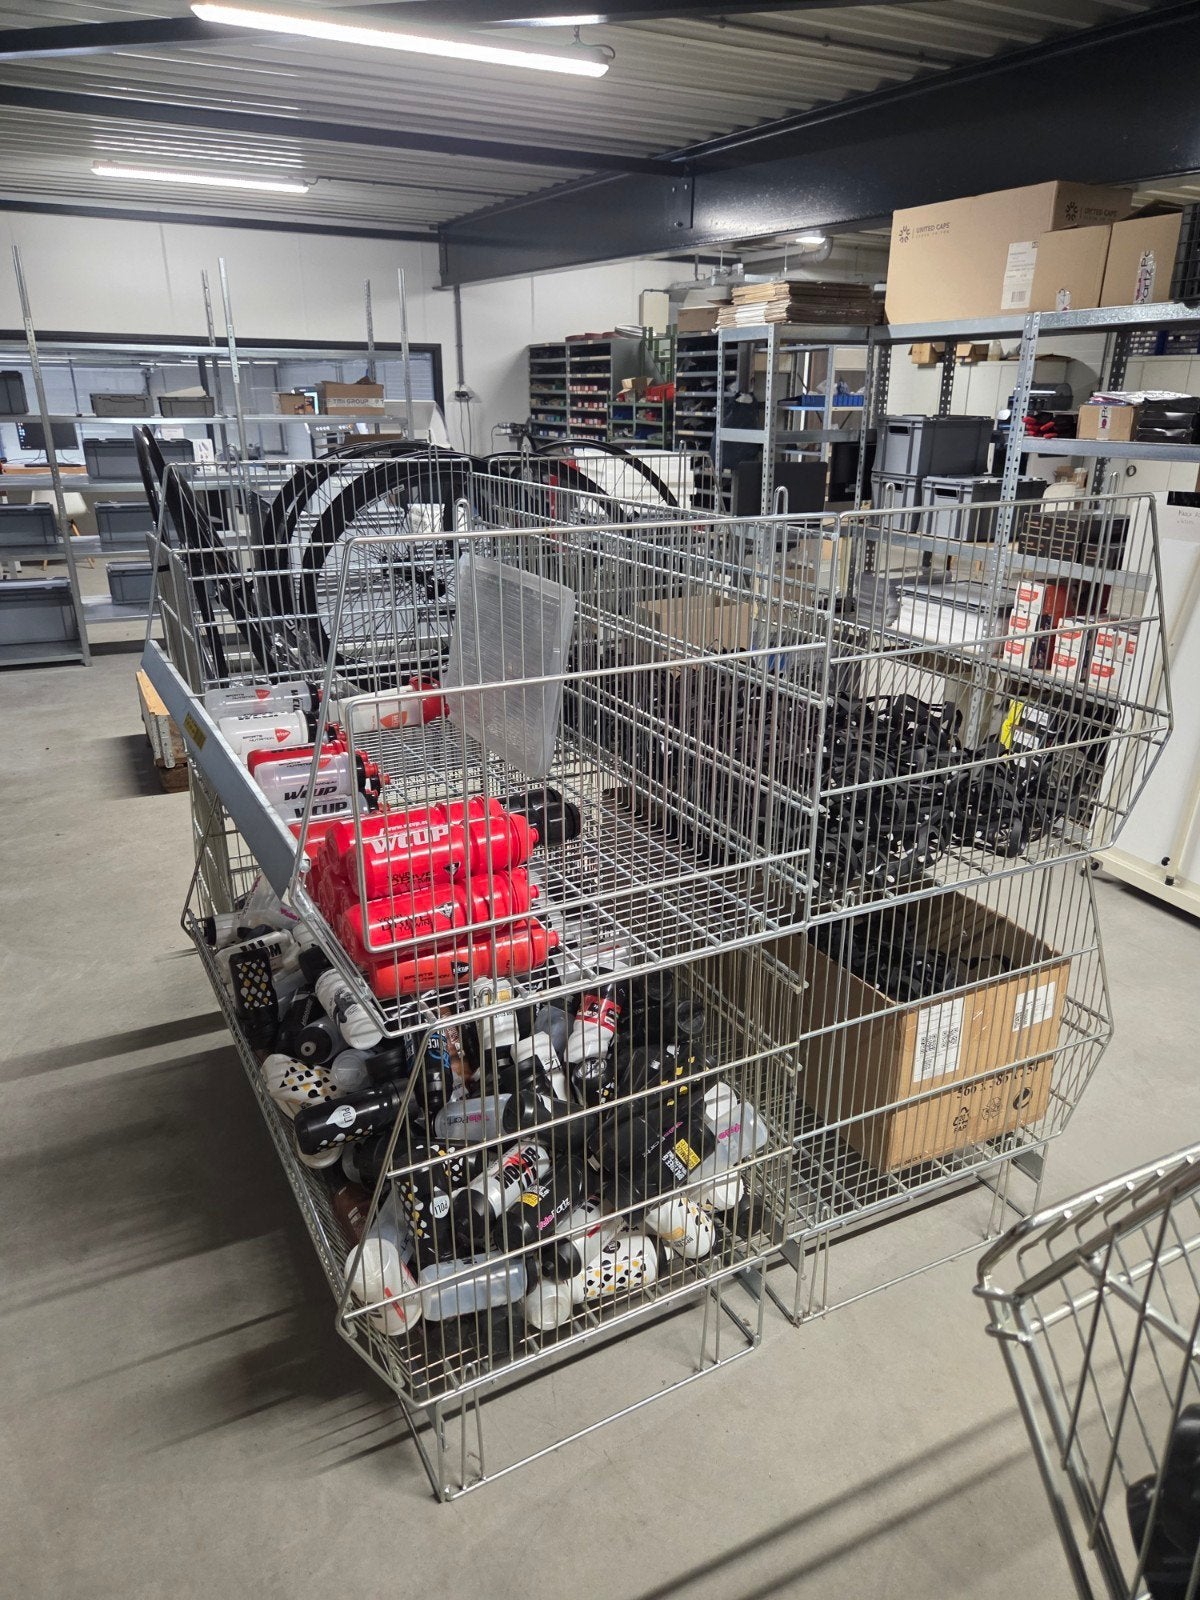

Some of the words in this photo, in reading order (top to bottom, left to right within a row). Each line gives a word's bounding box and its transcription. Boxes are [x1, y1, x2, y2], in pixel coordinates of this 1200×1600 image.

[915, 225, 936, 233] UNITED
[936, 221, 950, 231] CAPS
[370, 824, 449, 854] WCUP
